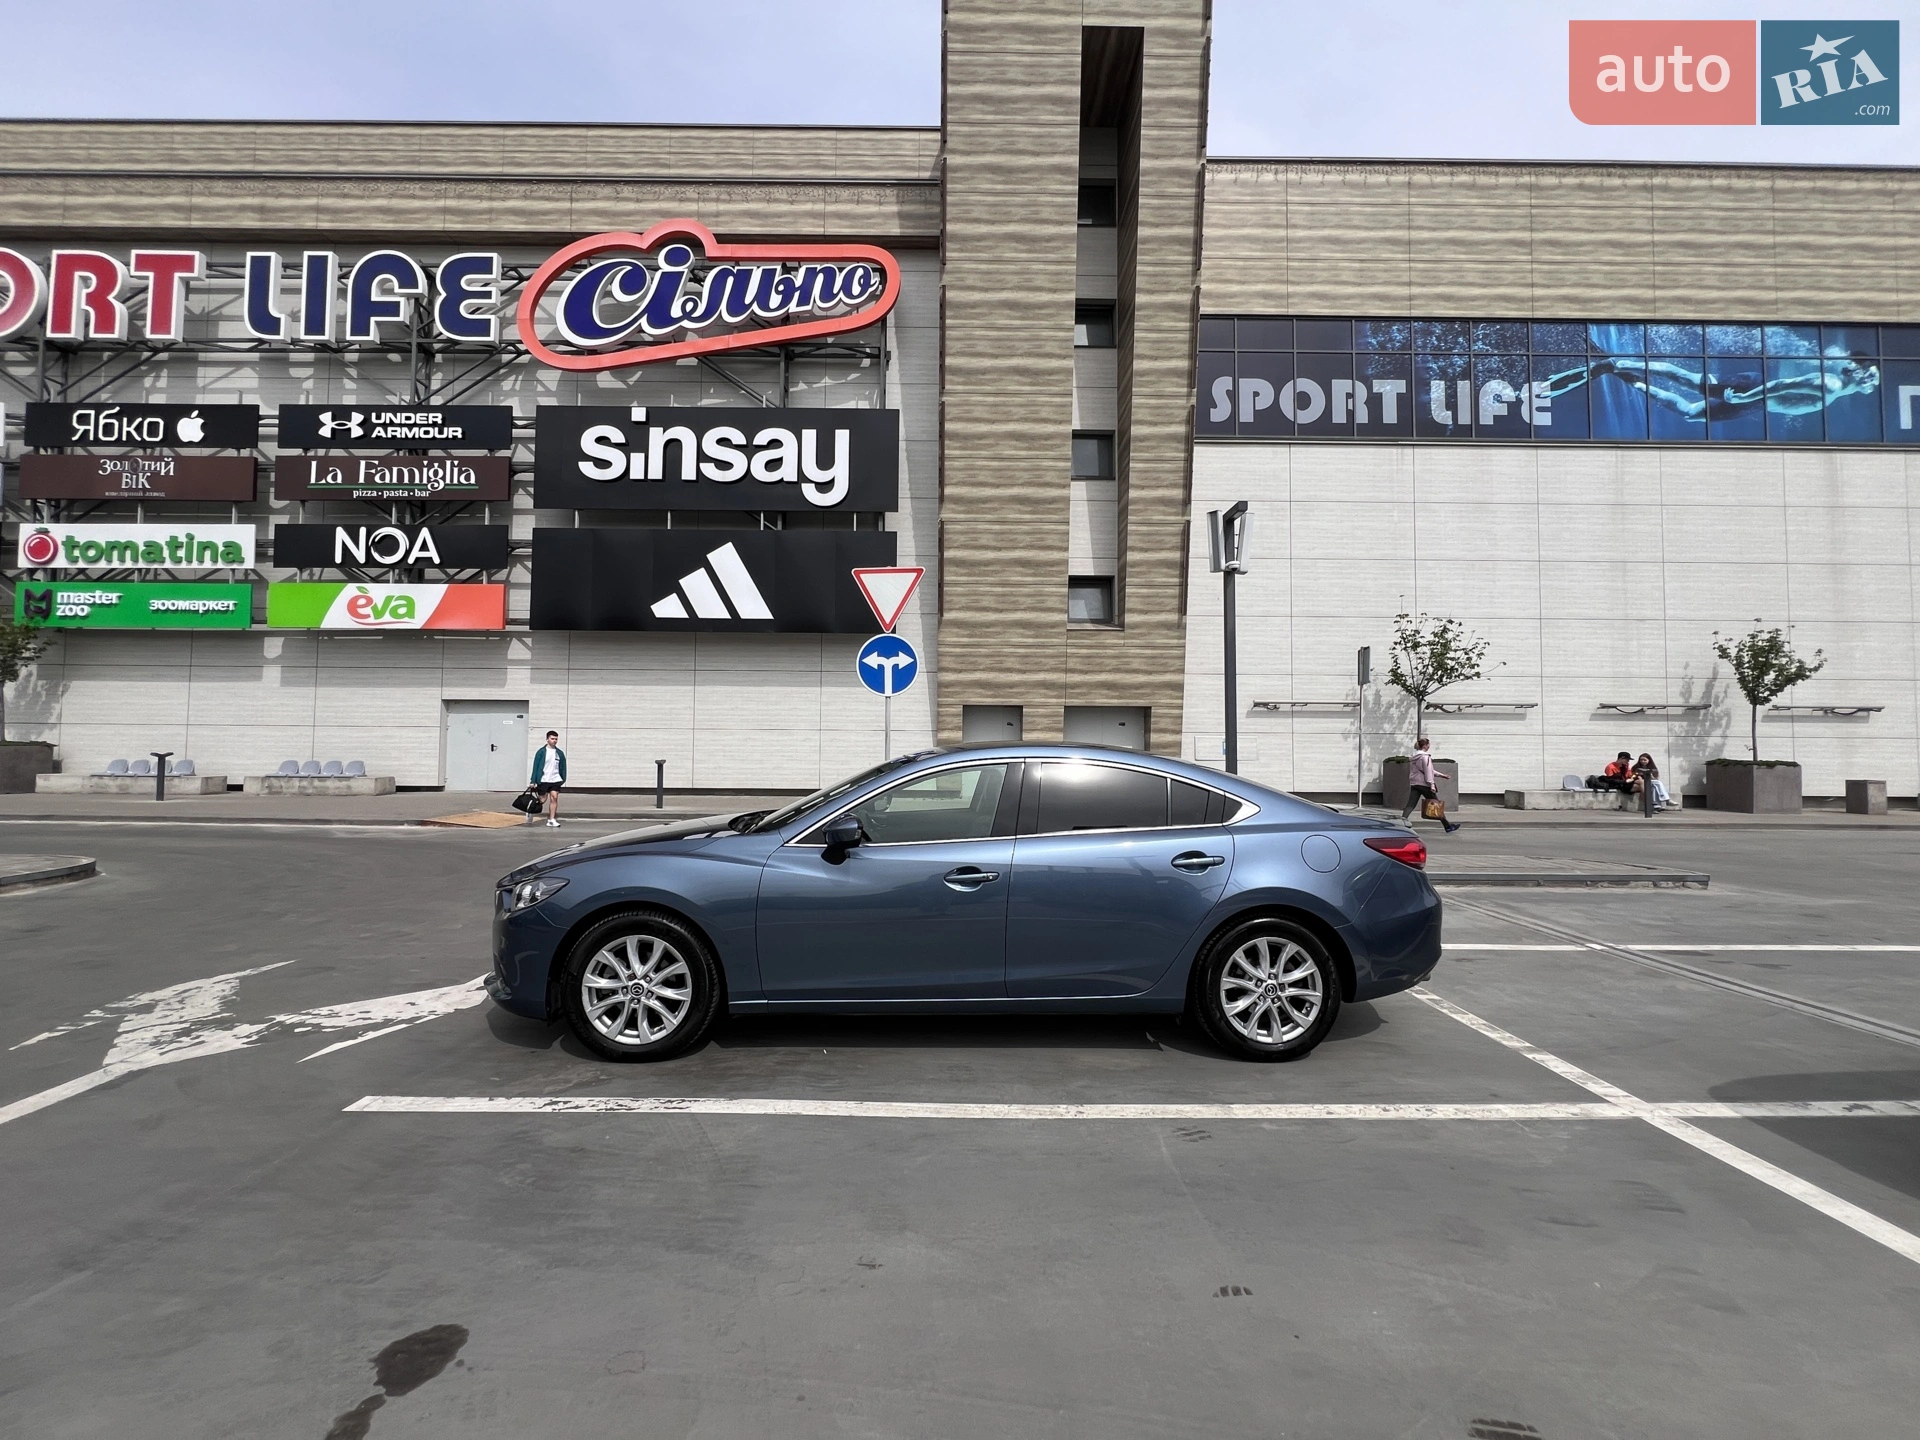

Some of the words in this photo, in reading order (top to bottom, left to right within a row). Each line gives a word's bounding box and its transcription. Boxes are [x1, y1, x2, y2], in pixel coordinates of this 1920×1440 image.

[244, 250, 502, 344] LIFE
[556, 244, 881, 346] Сільпо
[1210, 376, 1407, 425] SPORT
[1430, 379, 1552, 426] LIFE
[71, 406, 164, 442] Ябко
[371, 412, 442, 425] UNDER
[371, 426, 463, 439] ARMOUR
[578, 407, 850, 507] sinsay
[309, 460, 343, 485] La
[358, 460, 477, 491] Famiglia
[353, 489, 377, 498] pizza
[383, 489, 408, 498] pasta
[414, 489, 431, 497] bar
[62, 532, 246, 564] tomatina
[334, 526, 441, 565] NOA
[56, 605, 91, 617] zoo
[57, 590, 123, 605] master
[149, 600, 237, 614] зоомаркет
